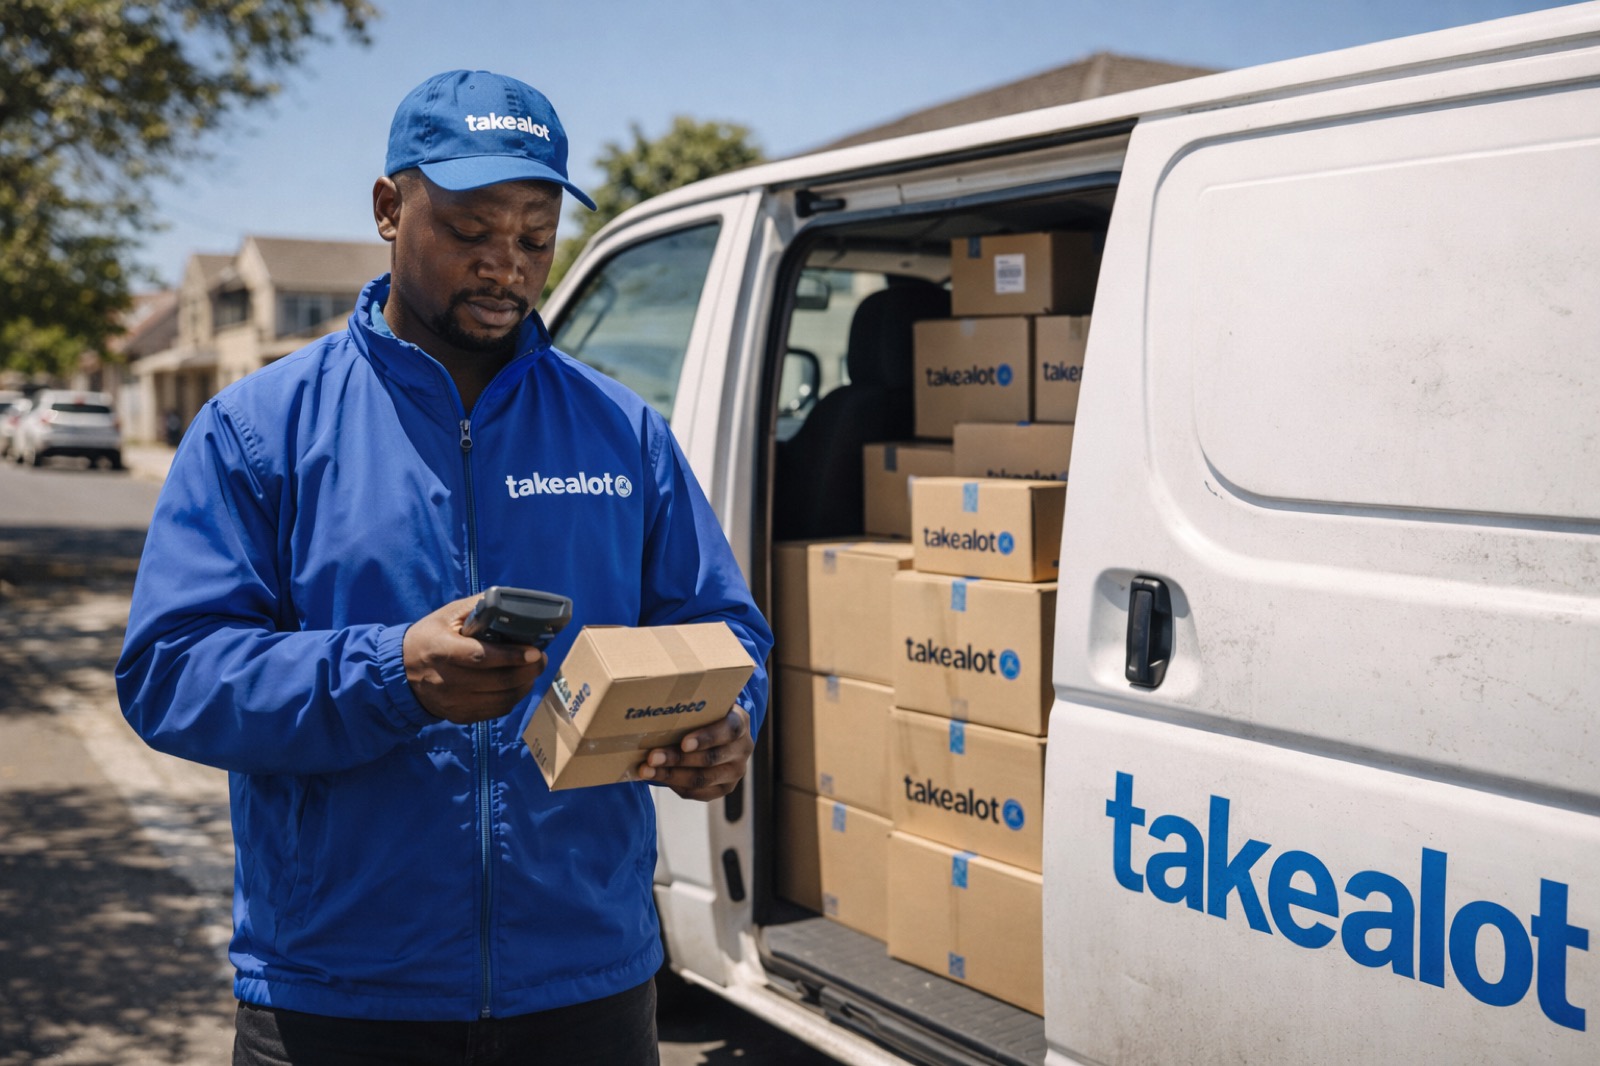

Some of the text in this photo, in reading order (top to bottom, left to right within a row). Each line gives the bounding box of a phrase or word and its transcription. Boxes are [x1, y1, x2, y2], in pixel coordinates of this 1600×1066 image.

[465, 112, 551, 142] takealot
[926, 365, 995, 386] takealot
[1043, 361, 1083, 382] take
[505, 472, 614, 499] takealot
[923, 527, 996, 552] takealot
[905, 637, 996, 674] takealot
[903, 774, 1000, 824] takealot
[1106, 770, 1589, 1032] takealot
